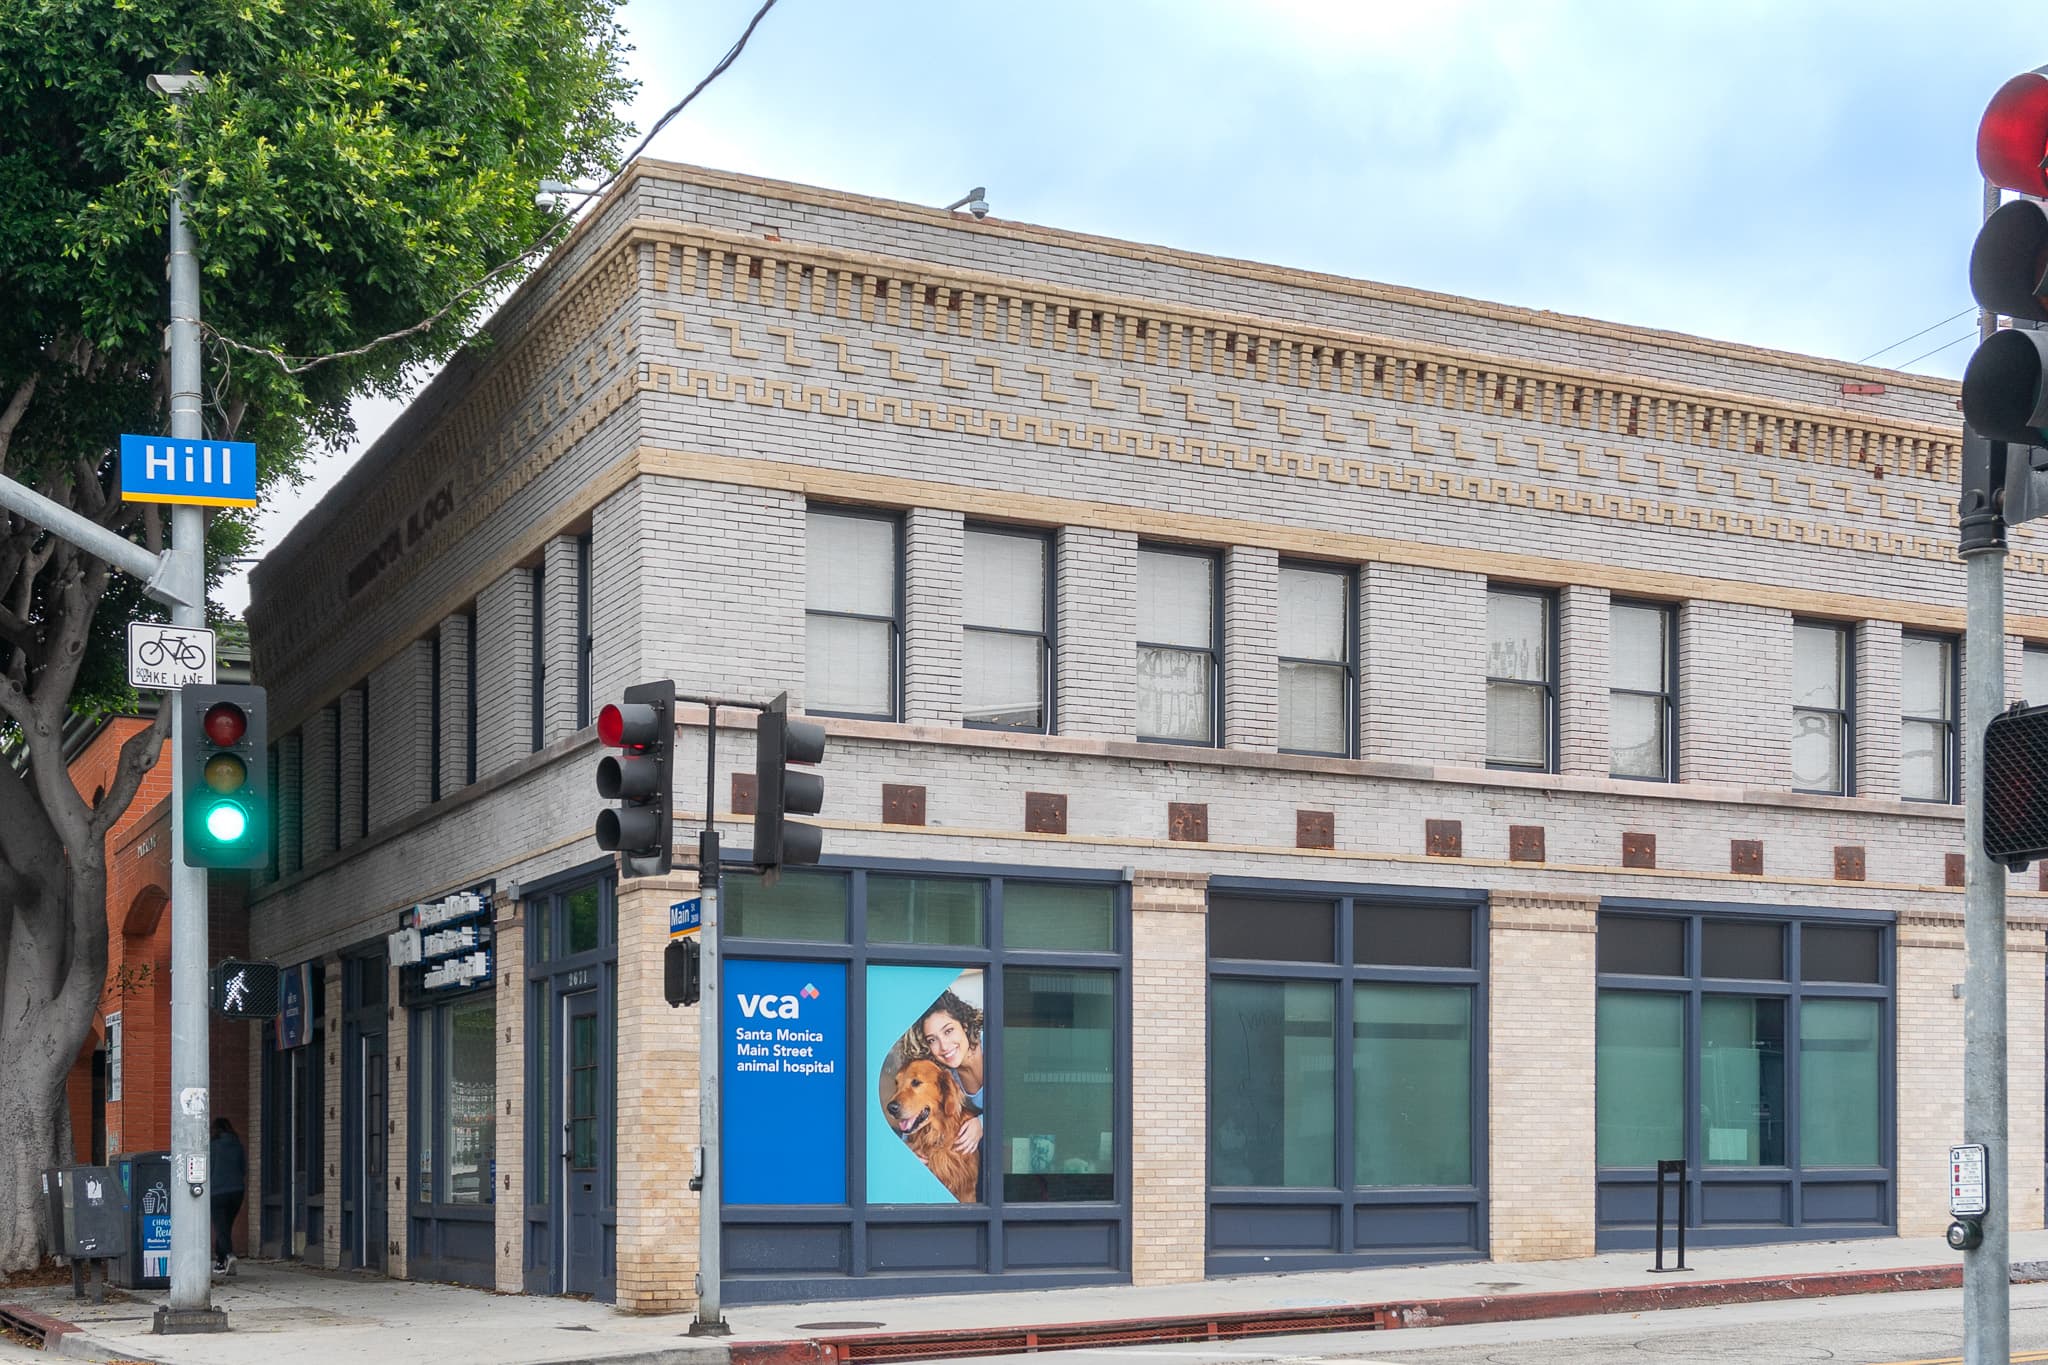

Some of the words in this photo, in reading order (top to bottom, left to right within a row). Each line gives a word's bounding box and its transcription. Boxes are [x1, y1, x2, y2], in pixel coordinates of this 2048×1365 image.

[146, 445, 231, 485] Hill
[174, 672, 203, 686] LANE
[671, 904, 690, 927] Main
[568, 970, 587, 986] 2671
[737, 994, 799, 1019] vca
[736, 1027, 773, 1041] Santa
[776, 1028, 823, 1042] Monica
[737, 1043, 769, 1057] Main
[773, 1044, 814, 1057] Street
[737, 1059, 779, 1072] animal
[783, 1060, 834, 1076] hospital
[152, 1218, 171, 1227] CHOOS
